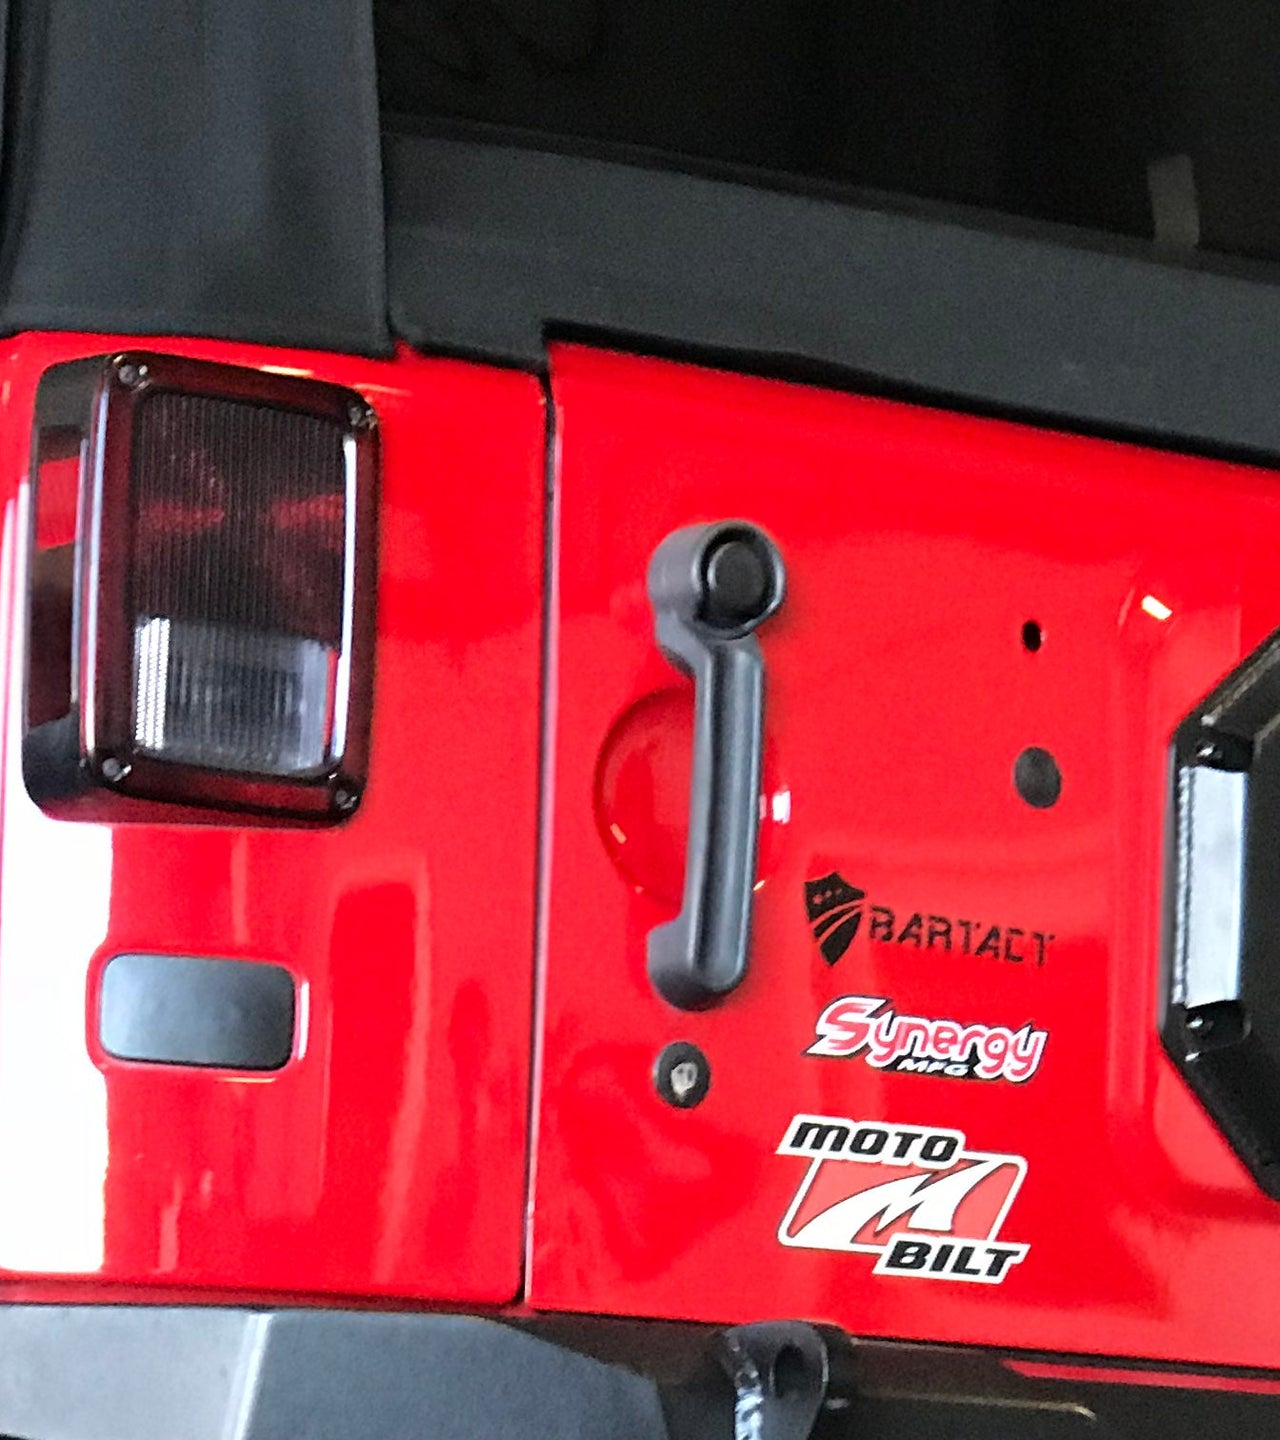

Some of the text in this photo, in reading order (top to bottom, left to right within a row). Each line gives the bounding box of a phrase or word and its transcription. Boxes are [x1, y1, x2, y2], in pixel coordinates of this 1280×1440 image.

[869, 905, 1055, 966] BARTACT
[806, 995, 1048, 1082] Synergy
[789, 1121, 959, 1162] MOTO
[885, 1240, 1021, 1277] BILT
